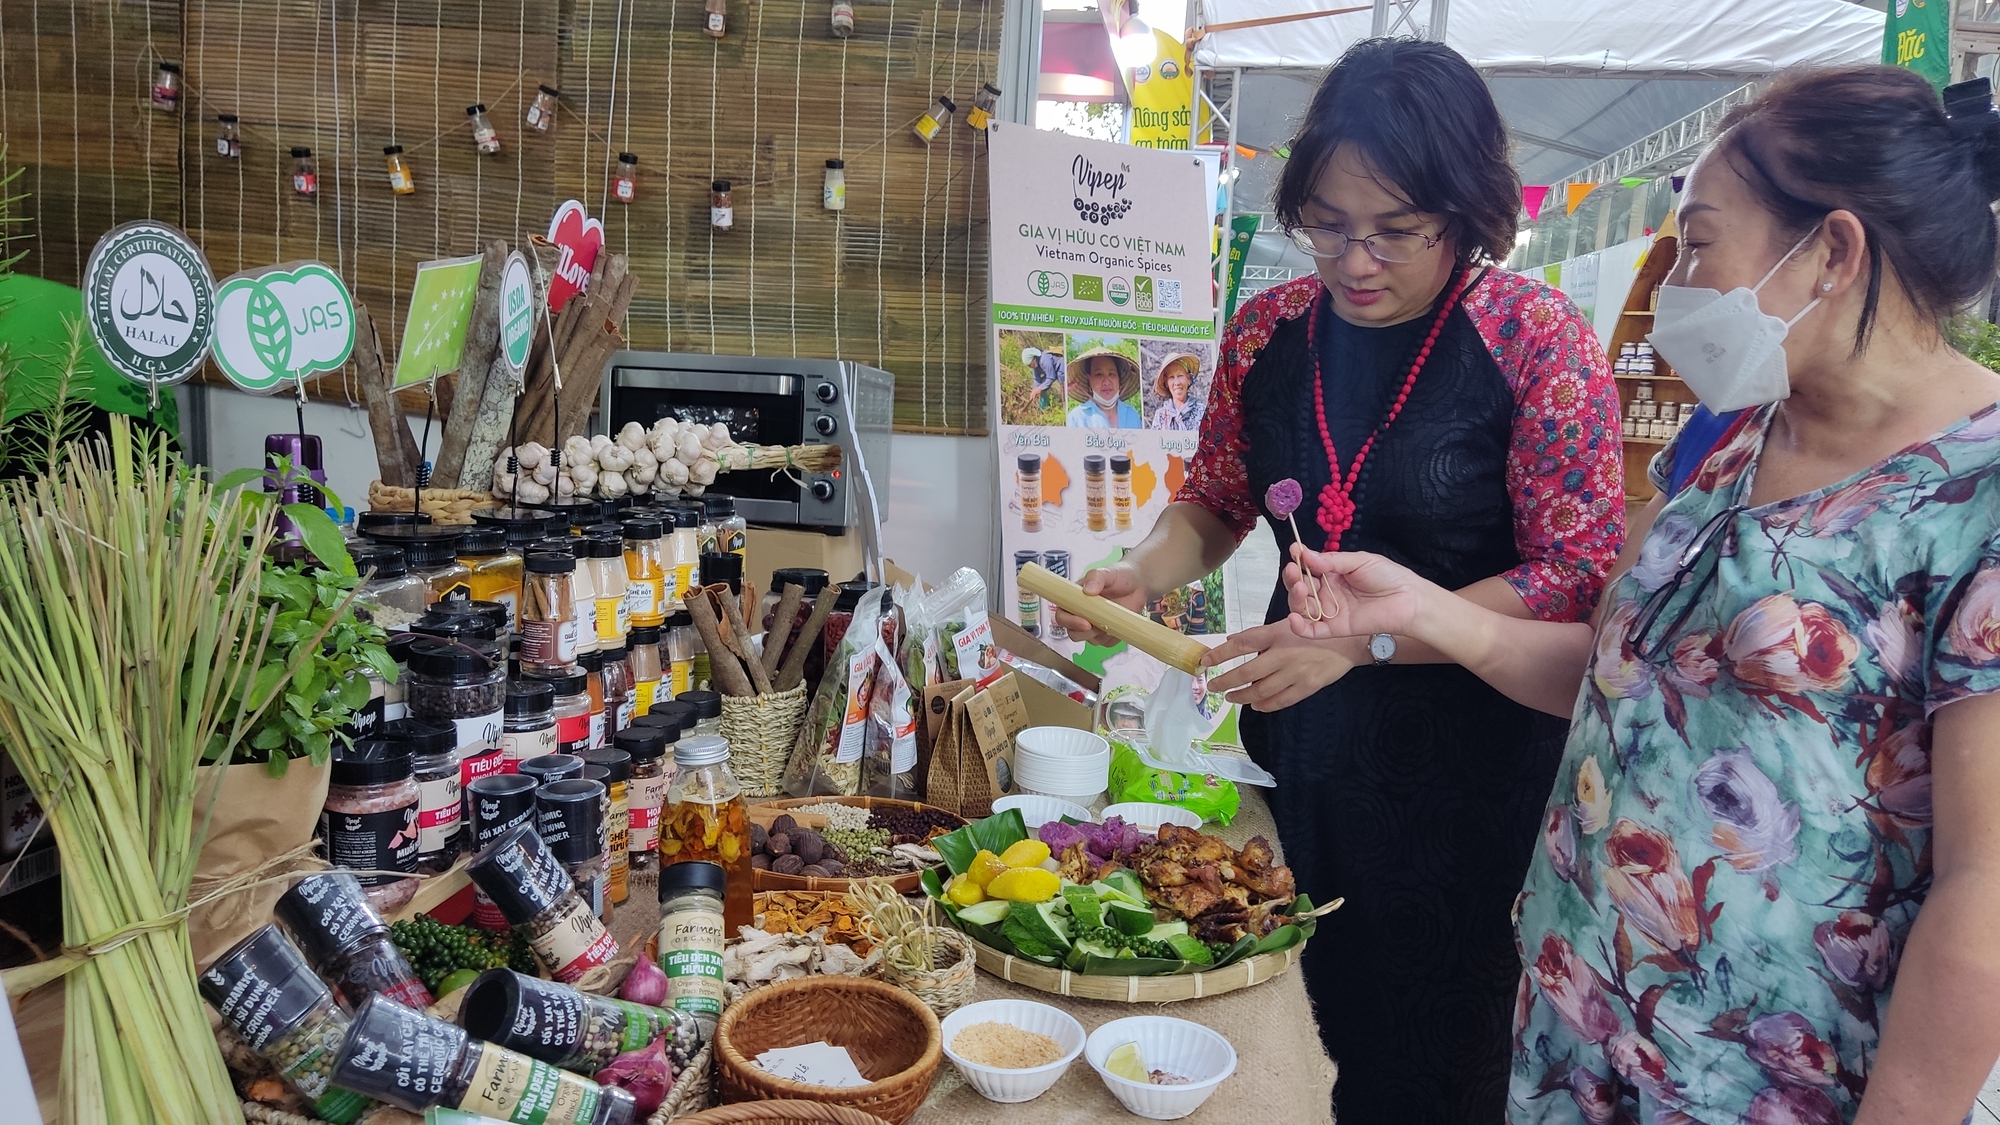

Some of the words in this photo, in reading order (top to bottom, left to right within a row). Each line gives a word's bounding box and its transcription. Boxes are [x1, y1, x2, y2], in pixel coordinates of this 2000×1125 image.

[1897, 28, 1926, 67] Đặc
[1133, 107, 1169, 131] Nông
[1072, 154, 1127, 199] Vipep
[1018, 223, 1045, 240] GIA
[1047, 226, 1062, 246] VỊ
[1065, 227, 1096, 246] HỮU
[1099, 232, 1120, 249] CƠ
[1123, 236, 1151, 256] VIỆT
[1155, 240, 1186, 258] NAM
[1035, 244, 1086, 263] Vietnam
[1088, 251, 1135, 270] Organic
[1137, 257, 1172, 274] Spices
[100, 265, 117, 311] HALAL
[114, 239, 197, 277] CERTIFICATION
[192, 277, 207, 334] AGENCY
[1051, 281, 1066, 290] JAS
[507, 283, 526, 317] USDA
[1136, 299, 1153, 310] FOOD
[293, 300, 343, 336] JAS
[998, 310, 1019, 321] 100%
[1020, 311, 1031, 323] TỰ
[1059, 315, 1079, 325] TRUY
[1079, 315, 1099, 327] XUẤT
[1122, 320, 1138, 331] GỐC
[1142, 323, 1157, 333] TIÊU
[1180, 324, 1200, 335] QUỐC
[1200, 324, 1210, 336] TẾ
[124, 325, 180, 348] HALAL
[1085, 433, 1104, 447] Bắc
[1106, 435, 1126, 449] Cạn
[1159, 436, 1183, 452] Lạng
[957, 635, 972, 648] GIA
[352, 711, 378, 733] Vipep
[469, 756, 492, 774] TIÊU
[435, 807, 451, 820] TIÊU
[478, 827, 492, 841] CỐI
[492, 822, 507, 837] XAY
[496, 843, 519, 866] Vipep
[529, 855, 543, 877] XAY
[299, 875, 325, 896] Vipep
[320, 908, 335, 927] CỐI
[330, 892, 348, 911] XAY
[329, 923, 341, 936] CÓ
[674, 935, 723, 946] ORGANIC
[585, 942, 606, 963] TIÊU
[668, 952, 689, 966] TIÊU
[690, 953, 710, 964] ĐEN
[681, 962, 705, 975] HỮU
[705, 964, 718, 976] CƠ
[245, 979, 270, 1010] DỤNG
[677, 980, 700, 988] Organic
[245, 986, 283, 1036] GRINDER
[542, 999, 554, 1024] XAY
[541, 1027, 554, 1045] CỐI
[554, 1032, 565, 1046] CÓ
[351, 1040, 378, 1067] Vipep
[400, 1039, 415, 1064] XAY
[430, 1037, 447, 1094] CERAMIC
[413, 1078, 427, 1092] CÓ
[516, 1092, 539, 1121] TIÊU
[530, 1069, 547, 1093] ĐEN
[537, 1079, 559, 1113] HỮU
